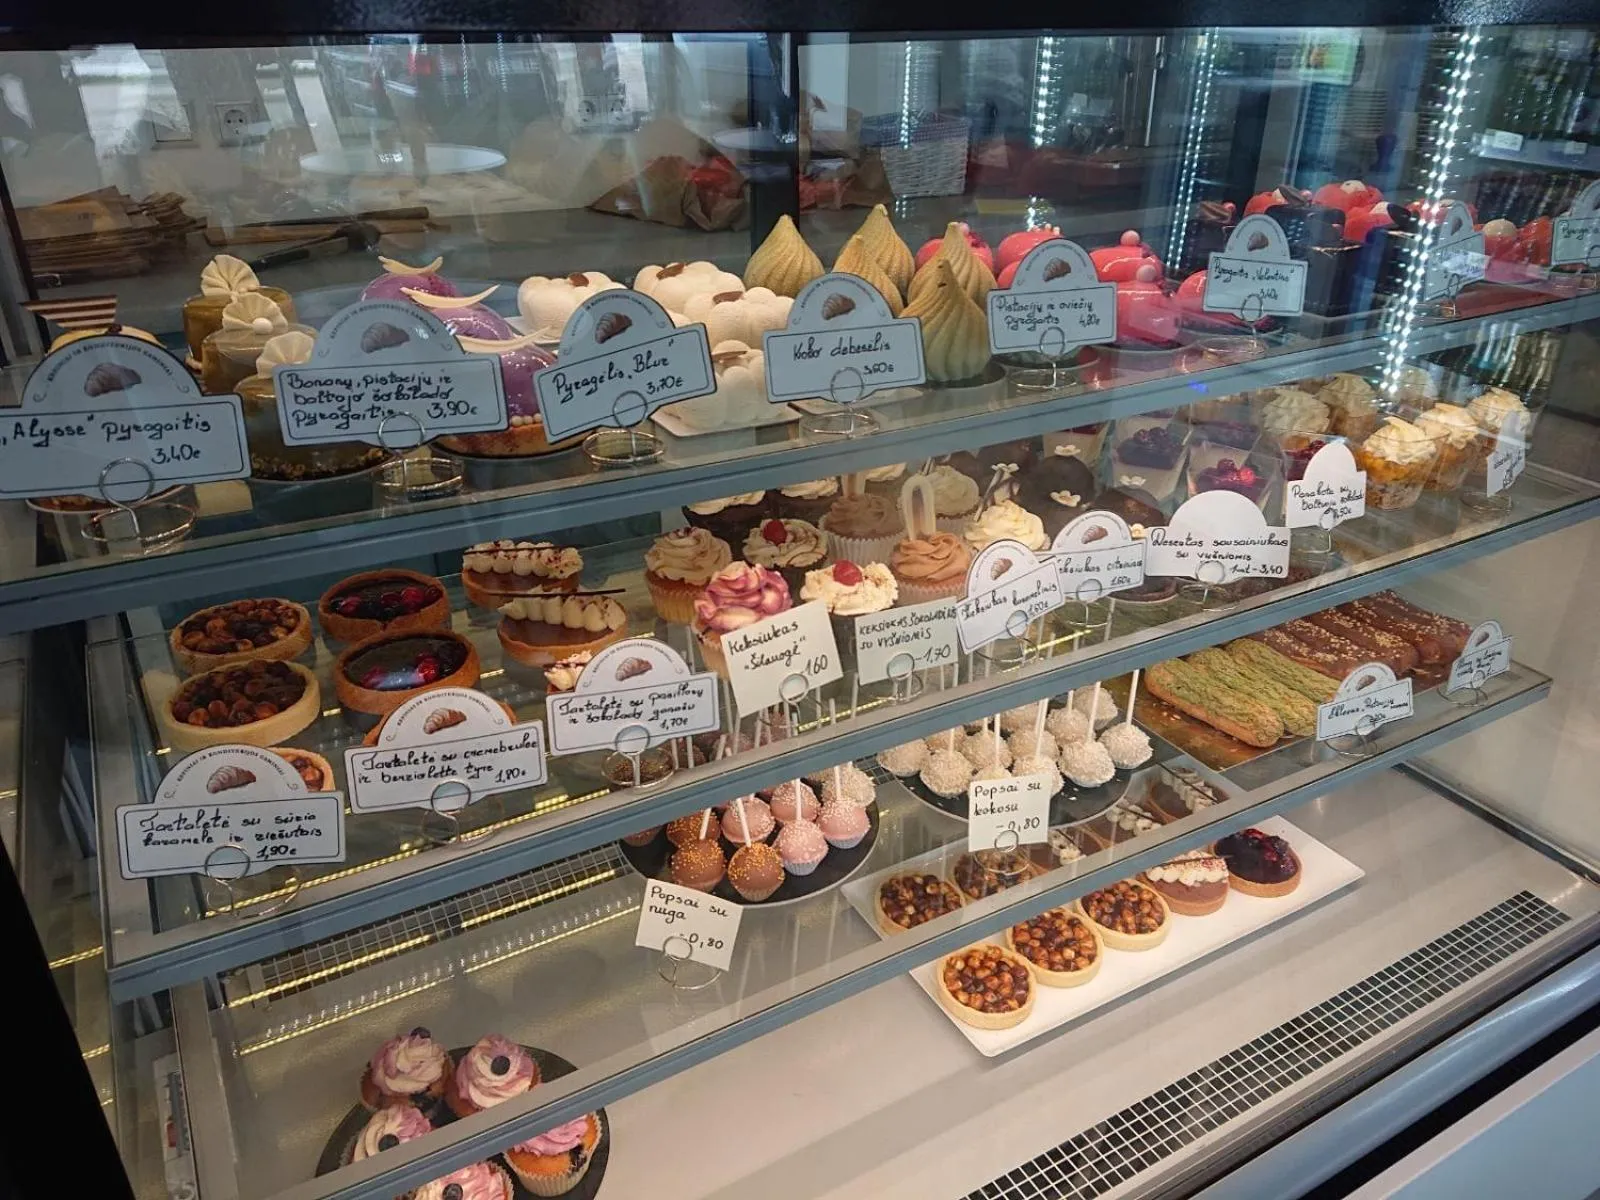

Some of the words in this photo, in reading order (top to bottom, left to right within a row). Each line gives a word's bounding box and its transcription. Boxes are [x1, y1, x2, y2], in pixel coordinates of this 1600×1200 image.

[646, 375, 684, 395] 3,70€
[974, 782, 1019, 800] Popsai
[1026, 781, 1042, 792] su
[973, 801, 1019, 816] kokosu
[650, 885, 700, 909] Popsai
[708, 905, 729, 918] su
[648, 904, 687, 925] nuga
